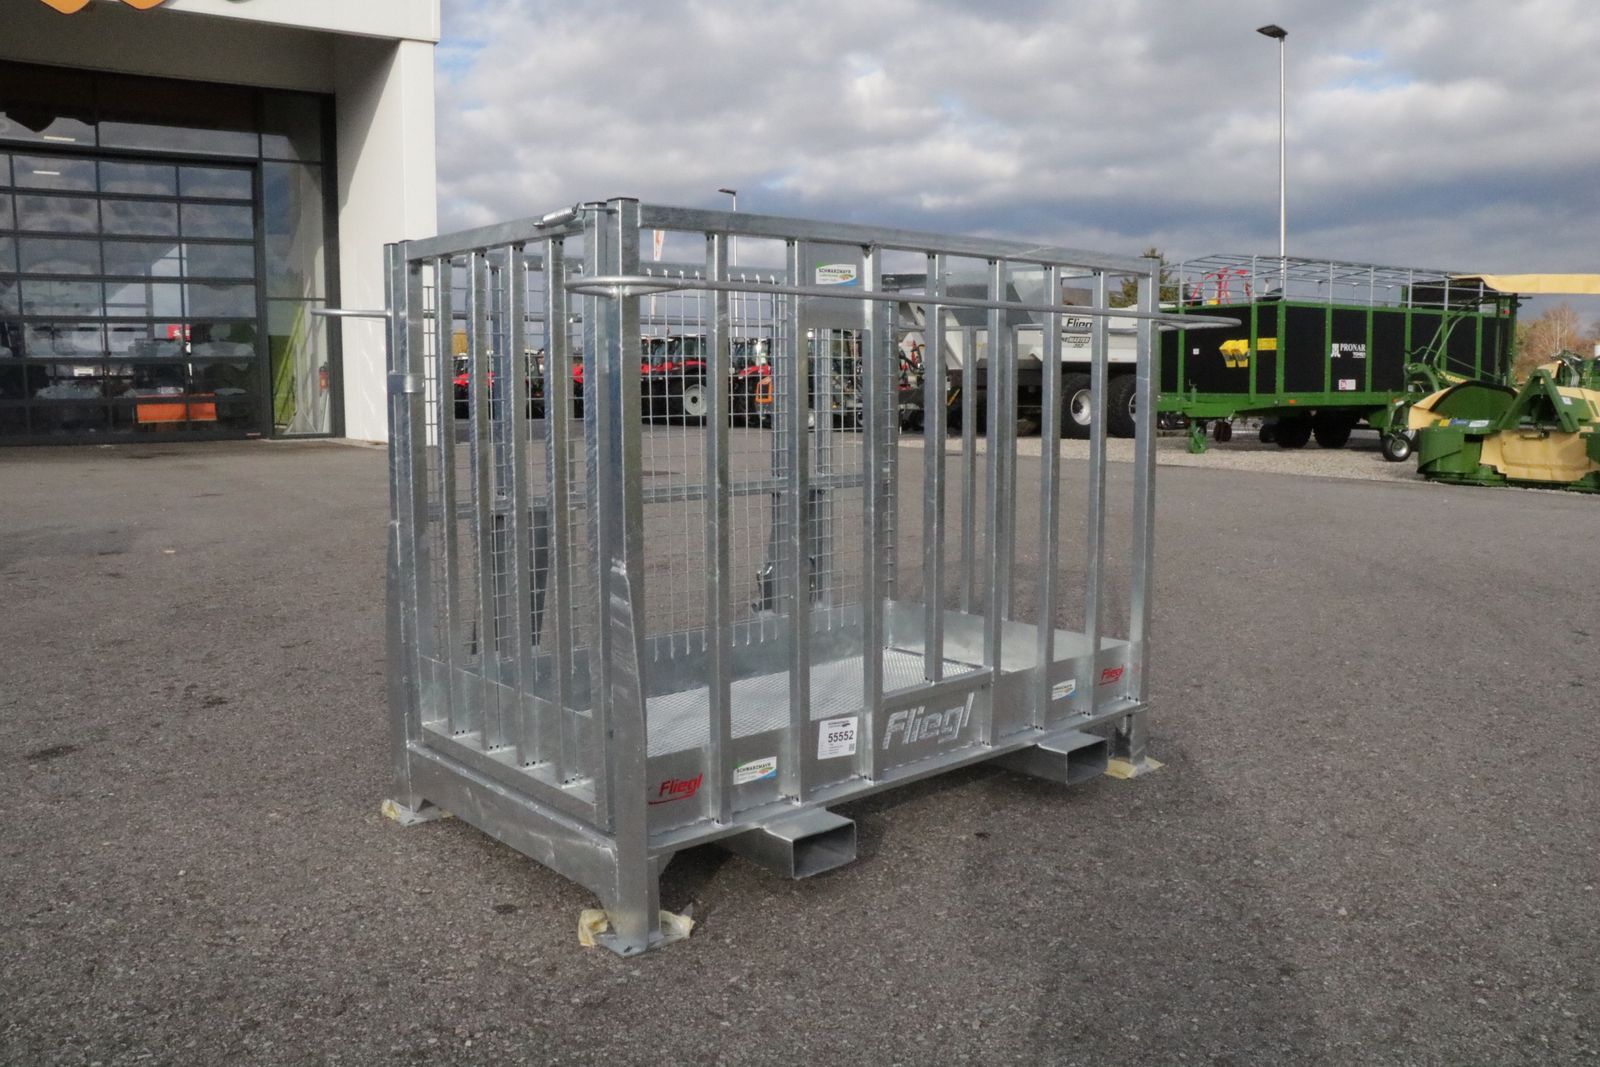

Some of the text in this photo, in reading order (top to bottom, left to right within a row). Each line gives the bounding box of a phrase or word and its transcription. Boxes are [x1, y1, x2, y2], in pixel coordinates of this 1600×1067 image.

[1340, 343, 1366, 352] PRONAR
[882, 692, 974, 750] Fliegl
[828, 730, 854, 743] 55552
[736, 762, 772, 773] SCHWARZMAYR
[658, 772, 704, 800] Fliegl
